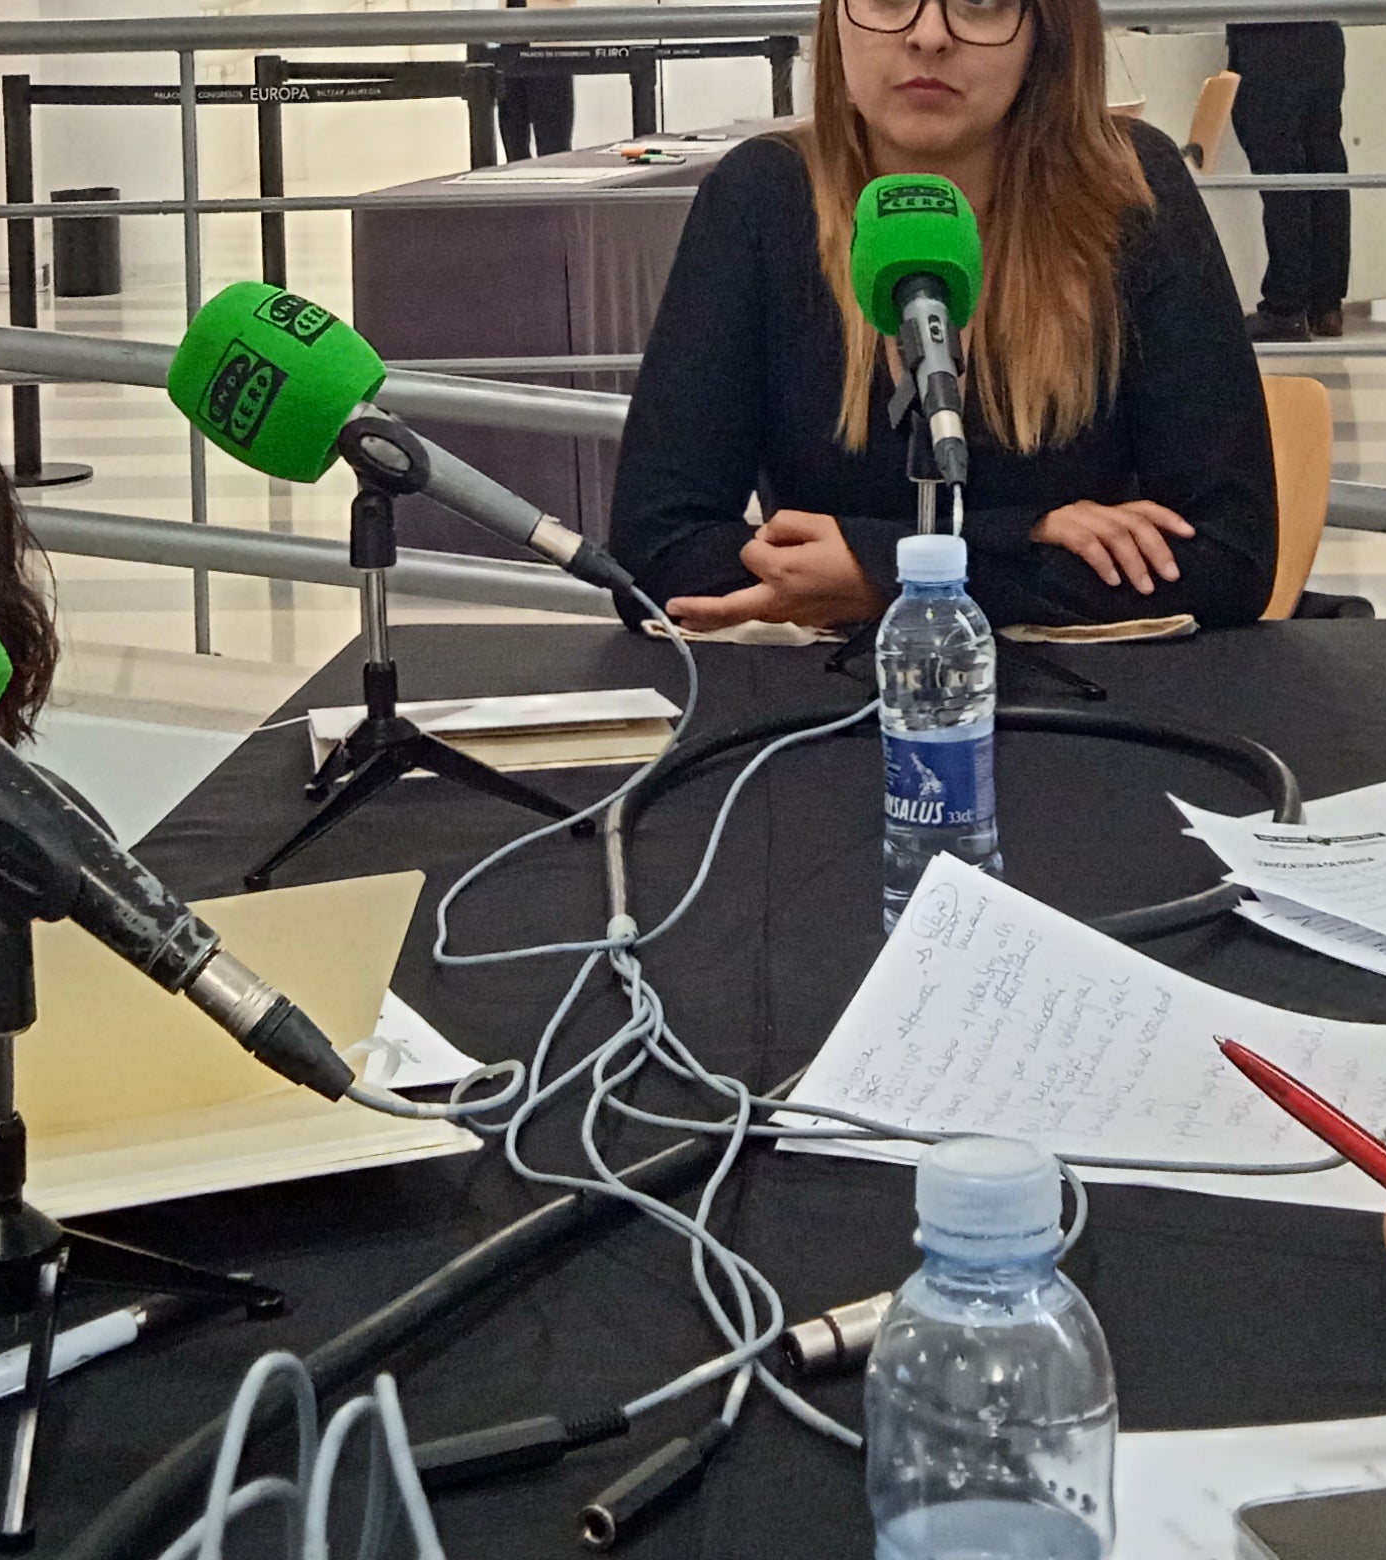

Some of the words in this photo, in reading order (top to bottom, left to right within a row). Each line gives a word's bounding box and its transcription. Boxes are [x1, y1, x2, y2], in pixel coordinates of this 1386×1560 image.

[249, 87, 310, 101] EUROPA
[213, 361, 246, 419] ONDA
[233, 375, 269, 431] CERO
